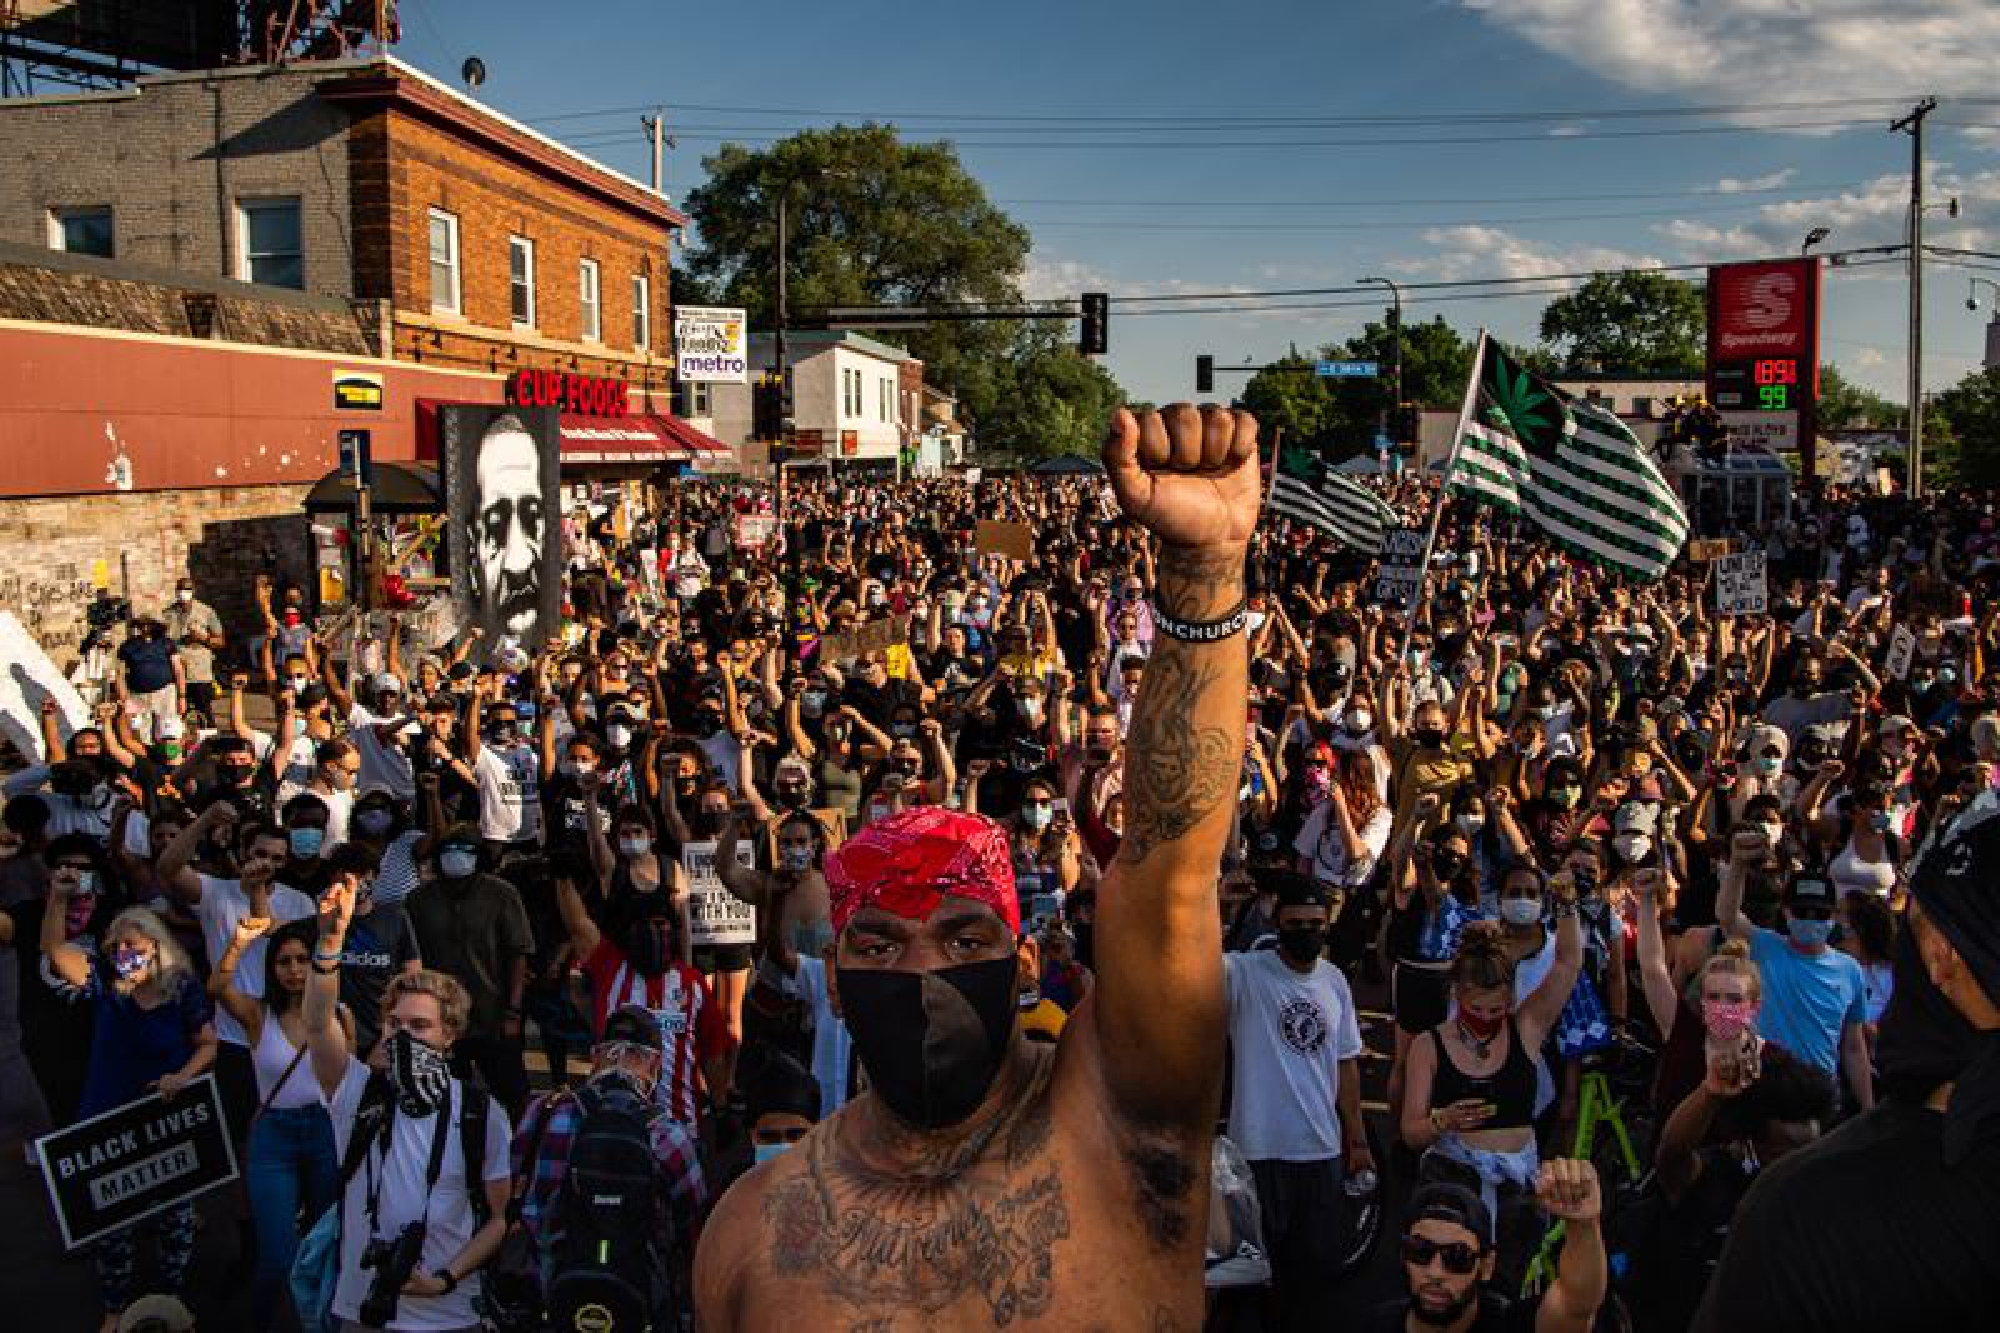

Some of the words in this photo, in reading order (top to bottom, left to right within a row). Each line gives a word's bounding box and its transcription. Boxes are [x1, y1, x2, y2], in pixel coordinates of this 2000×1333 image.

[1722, 331, 1797, 348] Speedway
[682, 355, 746, 374] metro
[519, 369, 561, 406] CUP
[566, 374, 628, 417] FOODS
[1760, 385, 1786, 409] 99
[726, 902, 751, 919] YOU
[57, 1130, 138, 1180] BLACK
[145, 1102, 210, 1142] LIVES
[101, 1152, 190, 1202] MATTER
